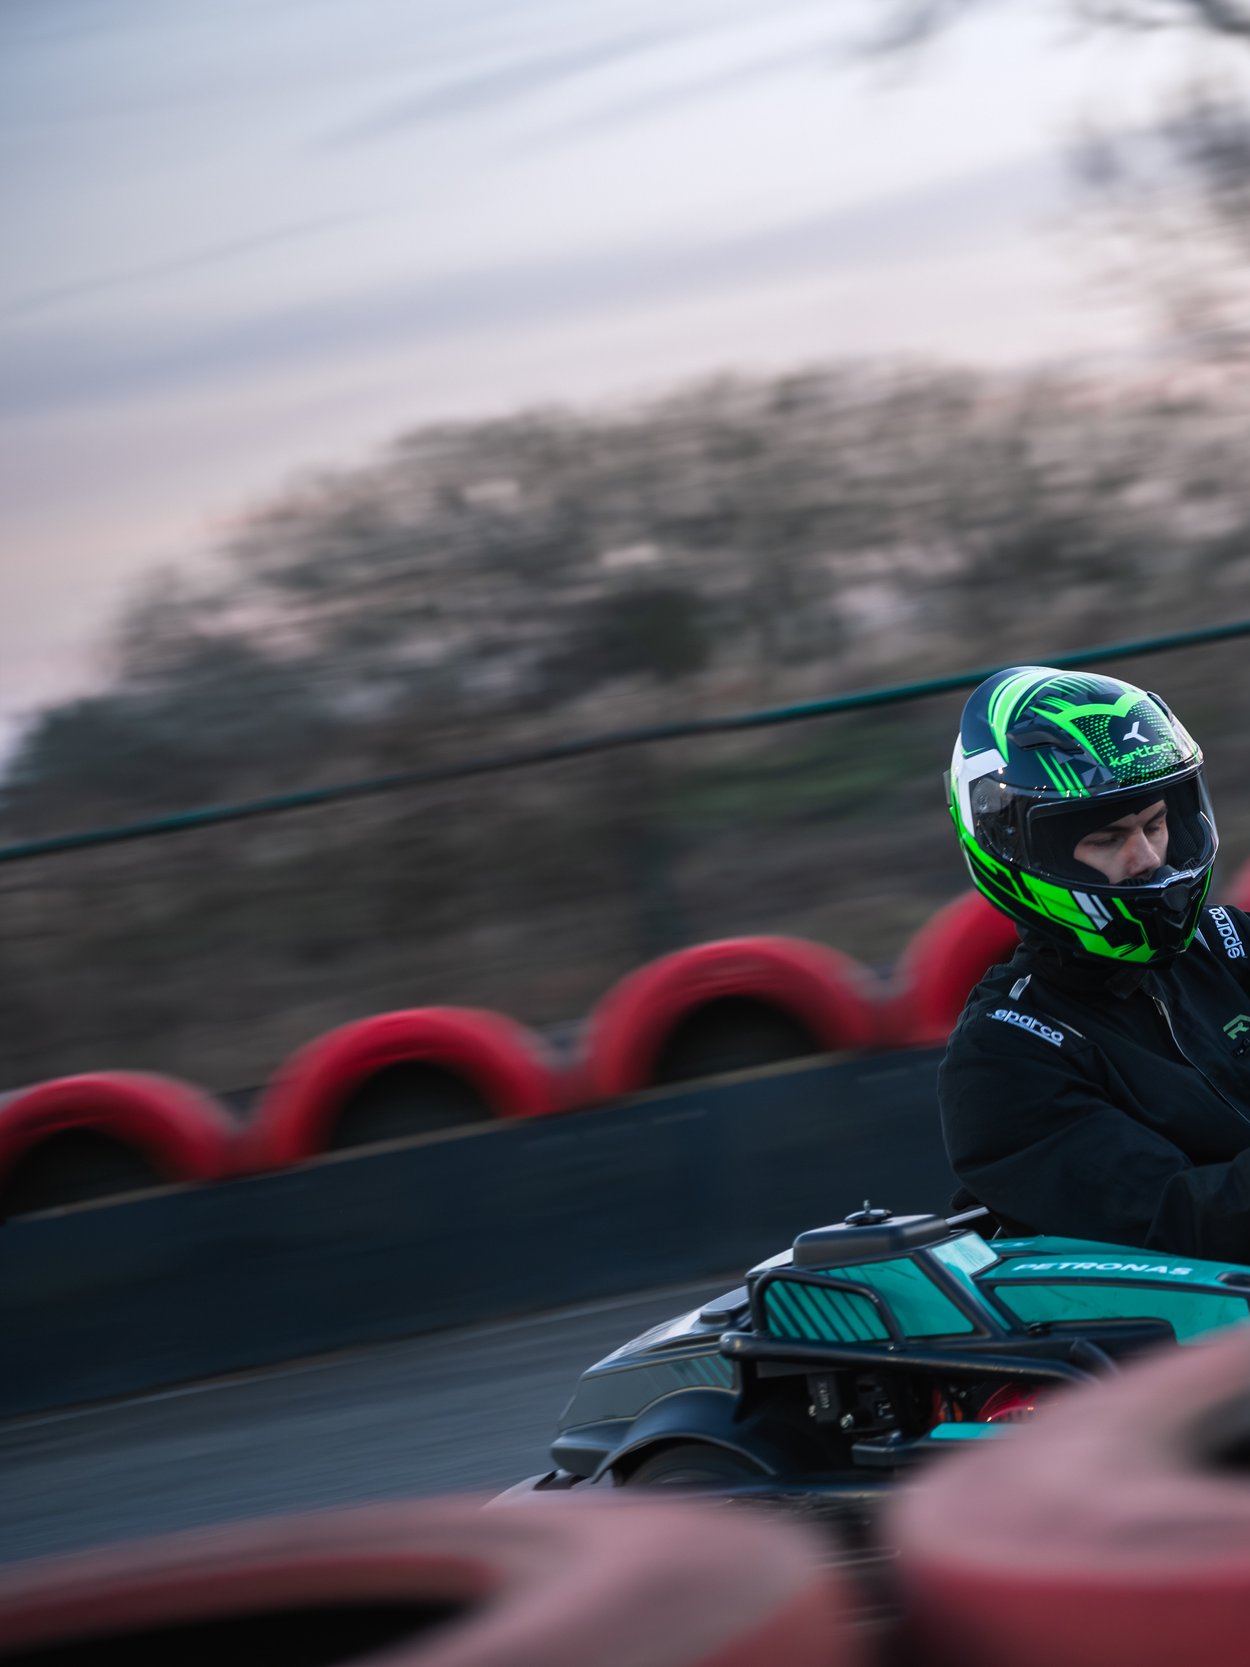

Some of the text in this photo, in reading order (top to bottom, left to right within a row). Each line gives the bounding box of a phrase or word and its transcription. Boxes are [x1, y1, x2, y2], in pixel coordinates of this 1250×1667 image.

[1109, 740, 1176, 767] karttech
[1208, 906, 1247, 958] sparco
[992, 1009, 1064, 1047] sparco
[1012, 1262, 1193, 1276] PETRONAS
